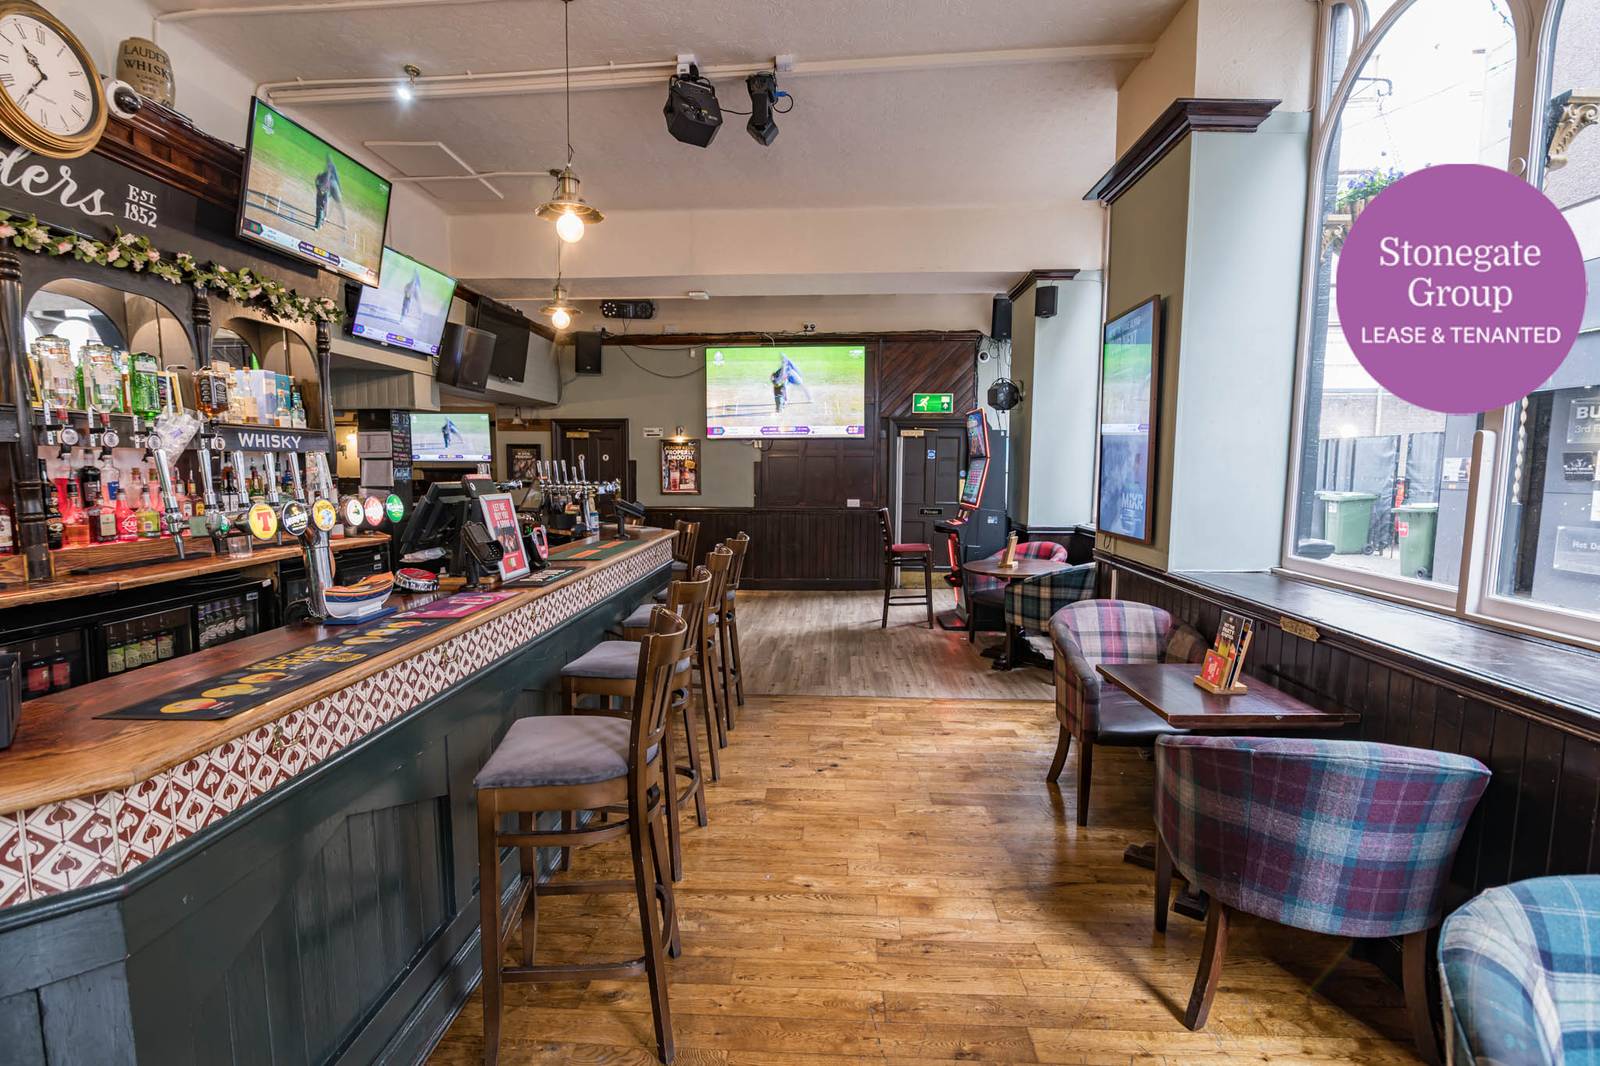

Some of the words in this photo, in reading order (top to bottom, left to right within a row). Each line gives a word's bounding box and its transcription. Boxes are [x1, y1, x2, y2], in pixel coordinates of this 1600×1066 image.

[127, 184, 157, 205] EST
[123, 202, 158, 228] 1852
[391, 412, 410, 425] SHTS
[238, 432, 302, 449] WHISKY
[257, 511, 272, 532] T
